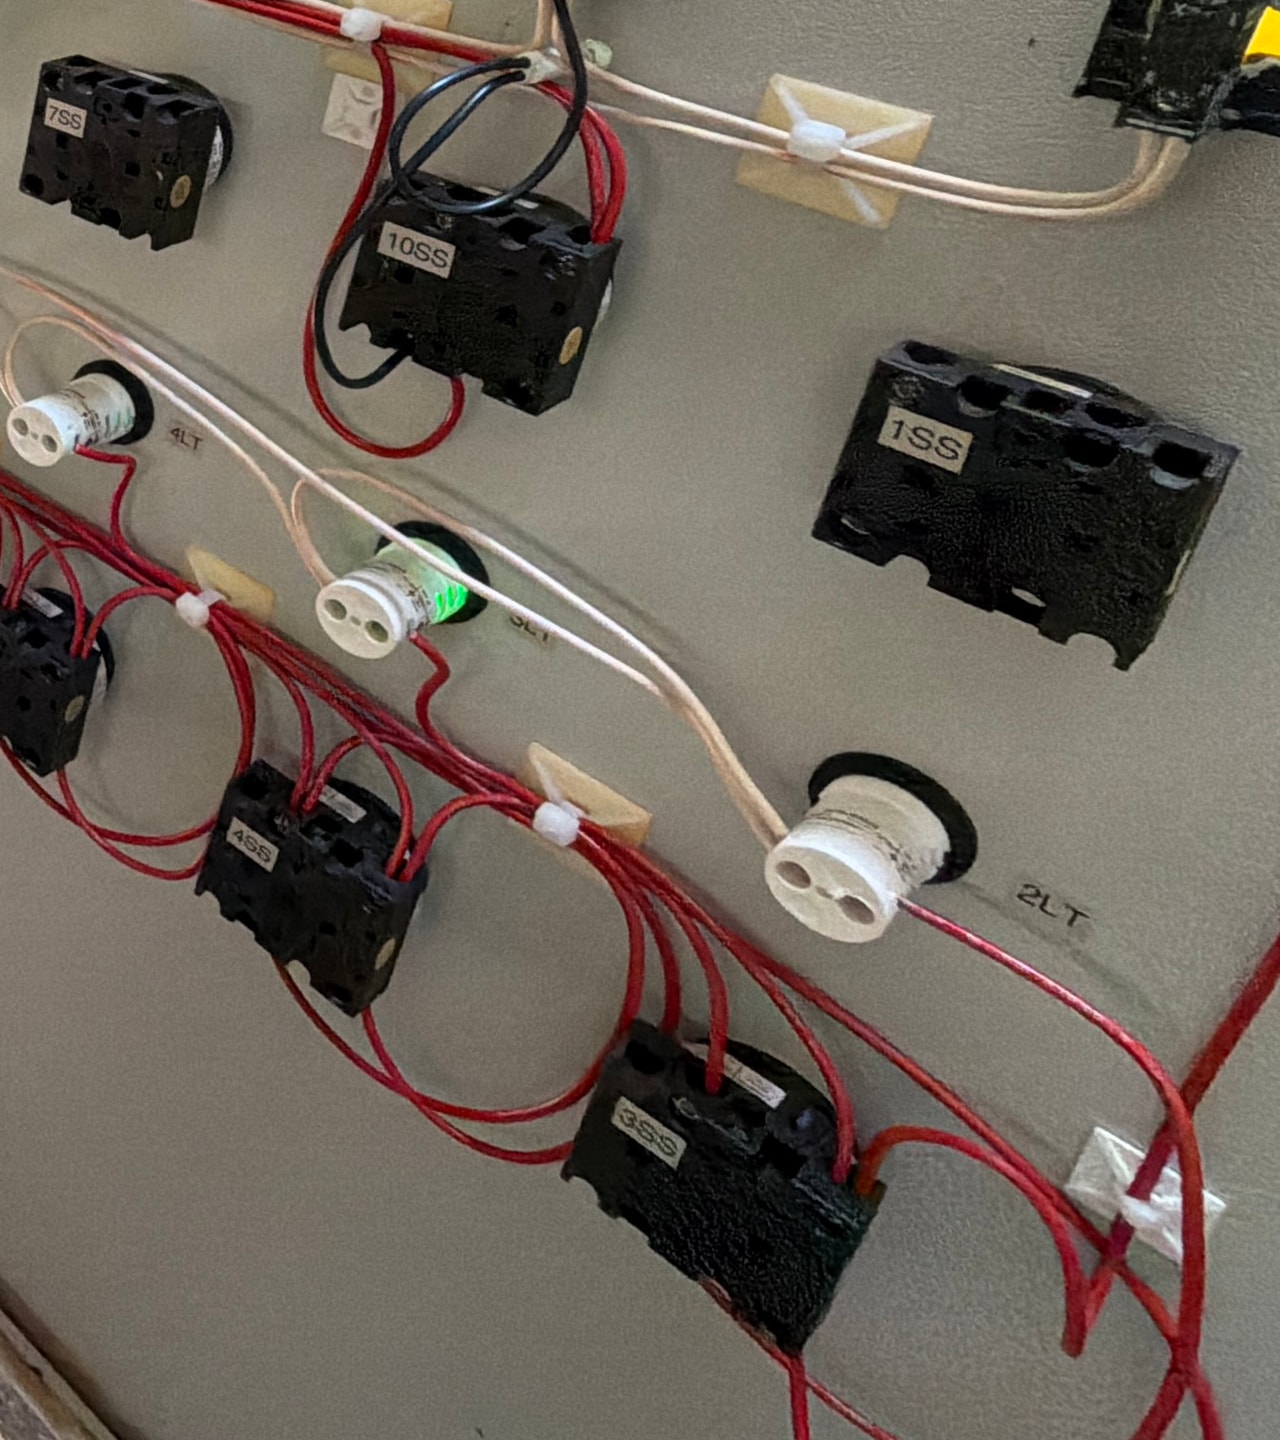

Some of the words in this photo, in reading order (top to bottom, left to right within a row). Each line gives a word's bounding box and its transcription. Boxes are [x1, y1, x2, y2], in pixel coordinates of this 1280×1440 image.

[49, 105, 81, 131] 7SS
[388, 231, 450, 269] 10SS
[170, 427, 202, 450] 4LT
[890, 419, 963, 461] 1SS
[233, 829, 271, 863] 4SS
[1016, 882, 1091, 927] 2LT
[621, 1110, 678, 1159] 3SS
